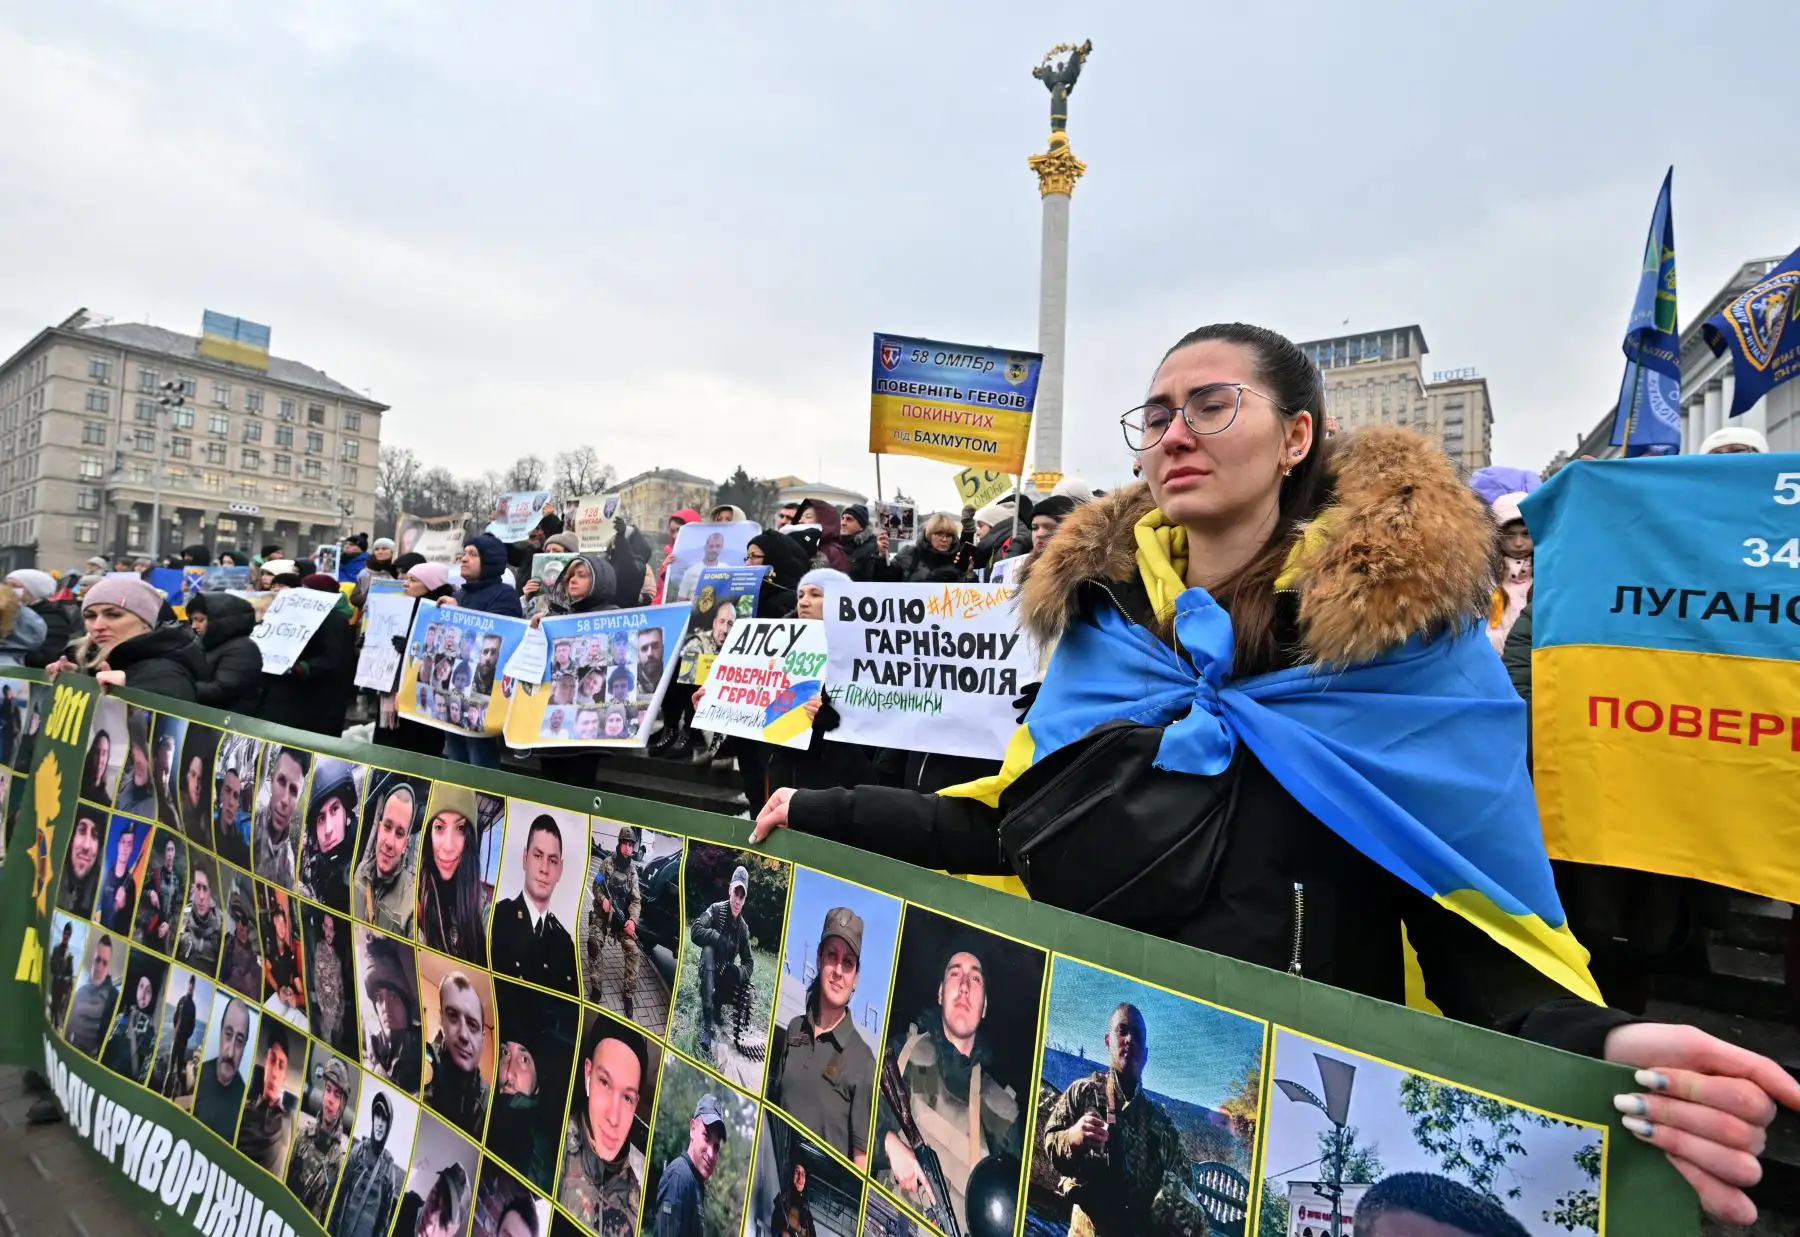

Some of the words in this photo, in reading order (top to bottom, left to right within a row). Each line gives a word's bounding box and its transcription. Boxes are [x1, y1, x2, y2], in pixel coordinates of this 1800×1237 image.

[911, 349, 929, 363] 58
[934, 352, 995, 373] ОМПБр
[1433, 367, 1480, 381] HOTEL
[877, 379, 963, 399] ПОВЕРНІТЬ
[967, 389, 1026, 407] ГЕРОЇВ
[901, 404, 994, 428] ПОКИНУТИХ
[893, 430, 910, 442] під
[914, 430, 998, 453] БАХМУТОМ
[1742, 537, 1800, 569] 34
[440, 610, 451, 621] 58
[453, 613, 495, 631] БРИГАДА
[576, 619, 590, 632] 58
[593, 613, 648, 631] БРИГАДА
[839, 596, 925, 624] ВОЛЮ
[728, 624, 807, 658] АПСУ
[782, 650, 828, 677] 9937
[44, 684, 91, 746] 3011
